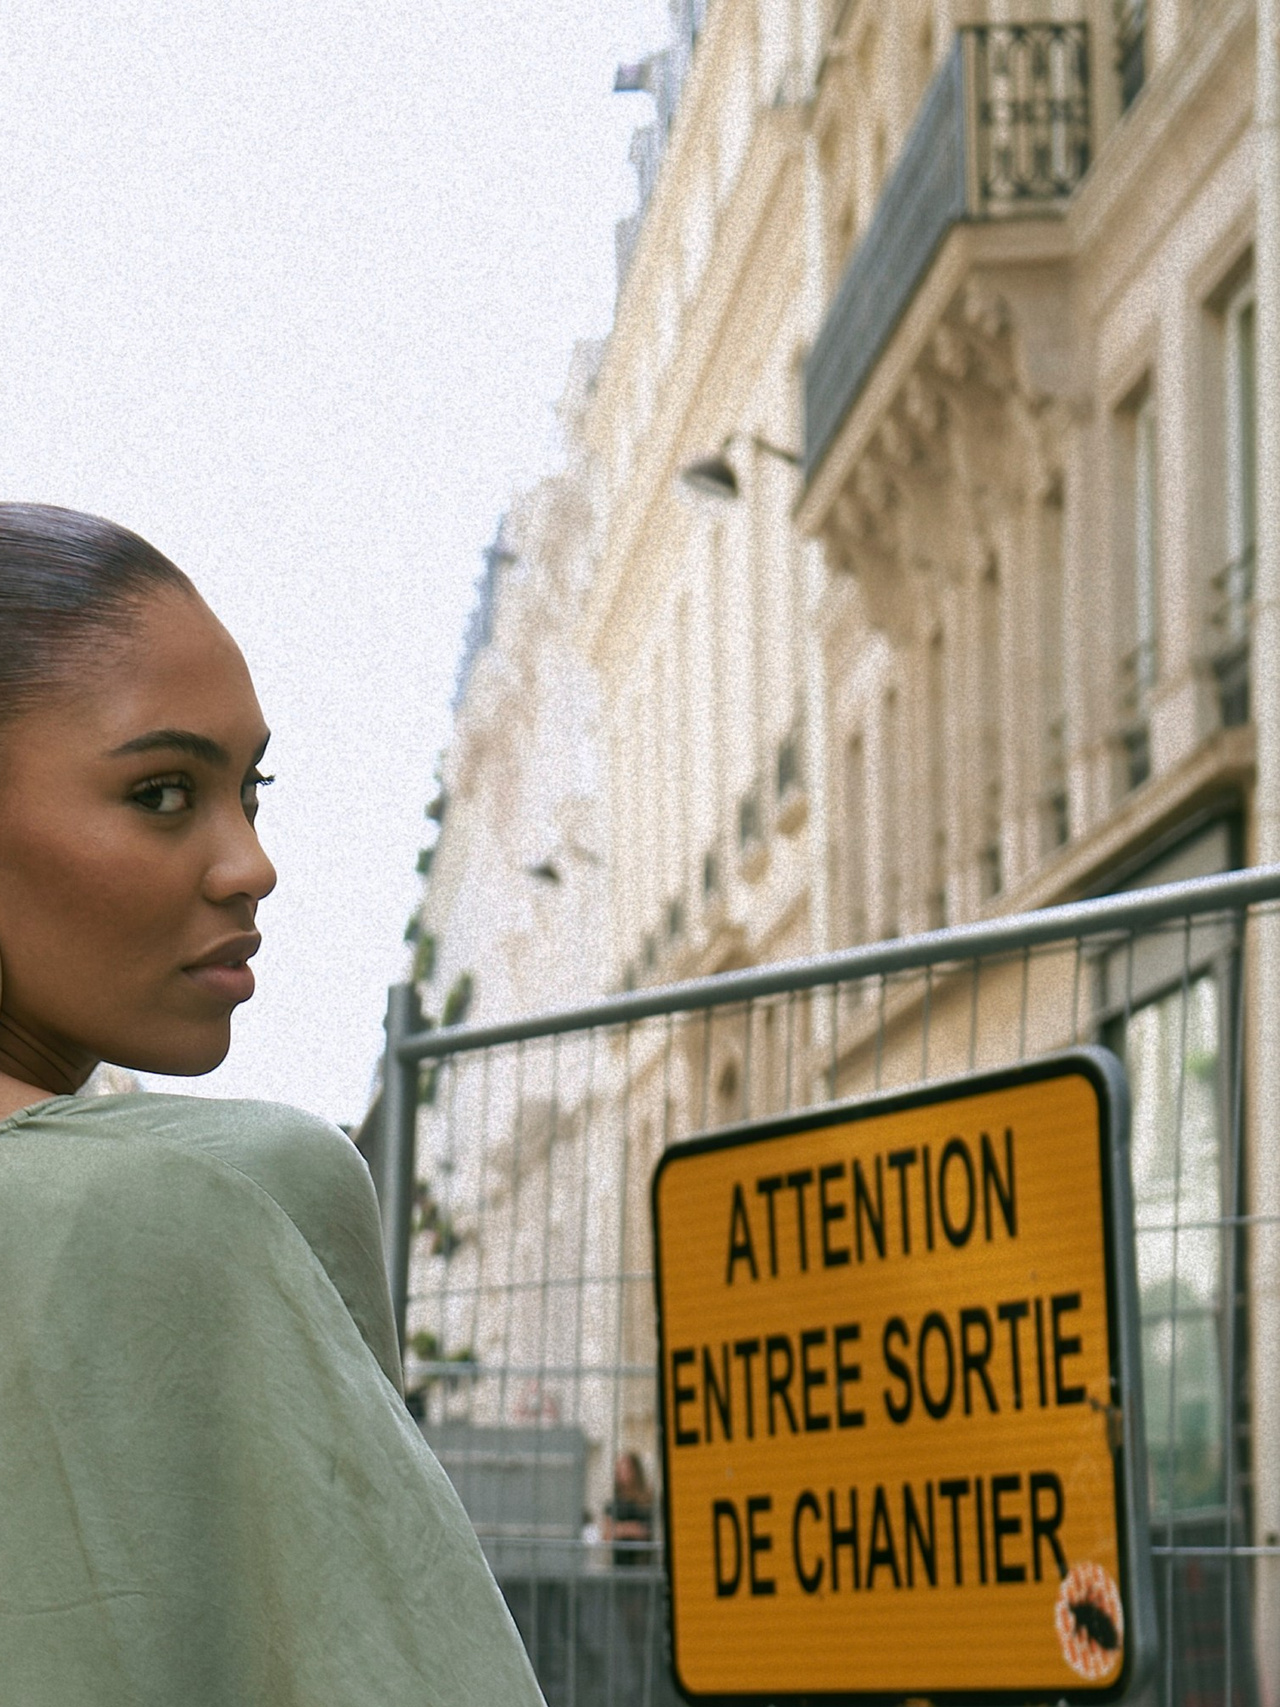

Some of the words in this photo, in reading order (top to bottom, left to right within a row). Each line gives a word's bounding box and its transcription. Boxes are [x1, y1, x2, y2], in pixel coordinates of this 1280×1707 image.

[725, 1129, 1018, 1285] ATTENTION
[670, 1322, 867, 1449] ENTREE
[881, 1291, 1087, 1427] SORTIE
[711, 1494, 778, 1600] DE
[791, 1470, 1069, 1596] CHANTIER
